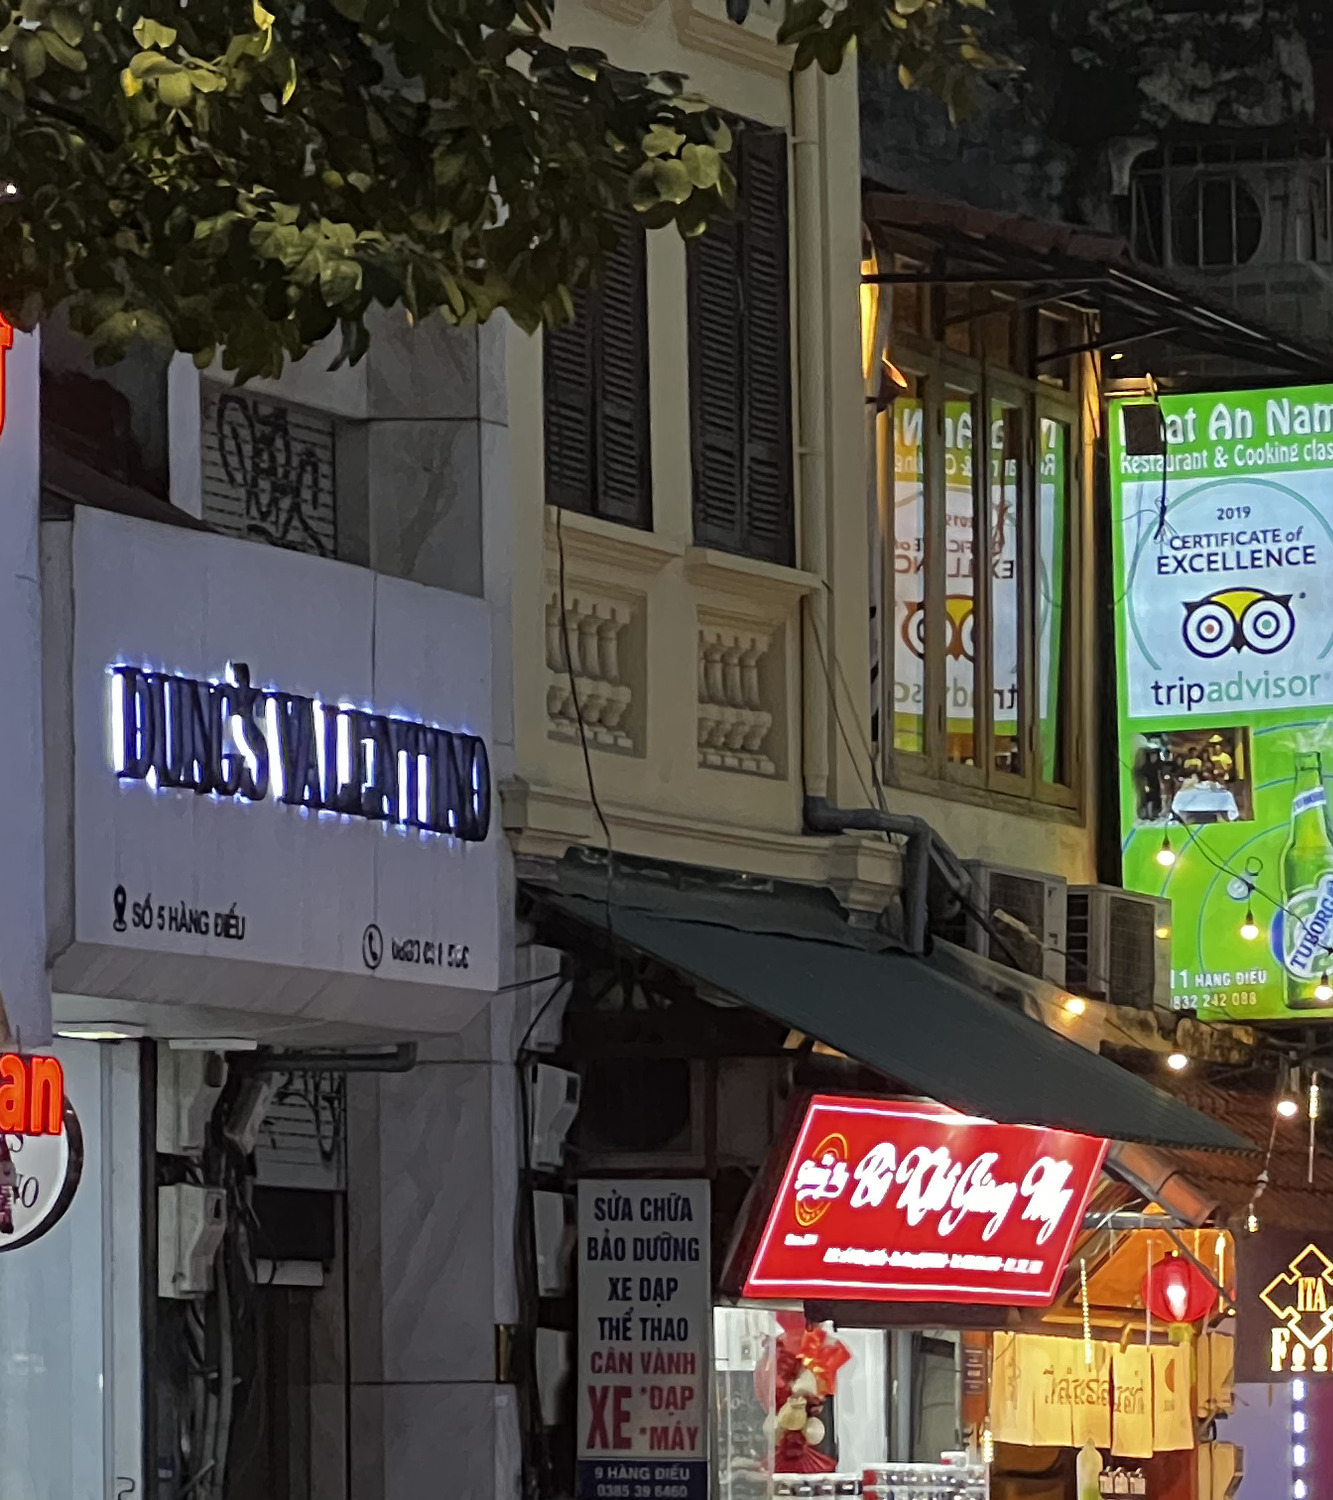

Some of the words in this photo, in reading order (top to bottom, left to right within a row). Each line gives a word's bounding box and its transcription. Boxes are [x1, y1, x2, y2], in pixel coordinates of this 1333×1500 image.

[1208, 403, 1253, 441] An
[1121, 450, 1208, 474] Restaurant
[1213, 446, 1228, 469] &
[1233, 441, 1299, 468] Cooking
[1216, 505, 1251, 521] 2019
[1169, 528, 1281, 551] CERTIFICATE
[1286, 526, 1304, 543] of
[1157, 545, 1317, 575] EXCELLENCE
[1150, 670, 1321, 712] tripadvisor
[594, 1189, 633, 1222] SỬA
[640, 1193, 693, 1222] CHỮA
[587, 1228, 626, 1261] BẢO
[633, 1231, 700, 1261] DƯỠNG
[608, 1277, 632, 1301] XE
[1297, 1277, 1326, 1312] ITA
[598, 1306, 634, 1341] THỂ
[640, 1317, 688, 1341] THAO
[640, 1346, 696, 1374] VÀNH
[586, 1386, 632, 1450] XE
[607, 1463, 651, 1480] HÀNG
